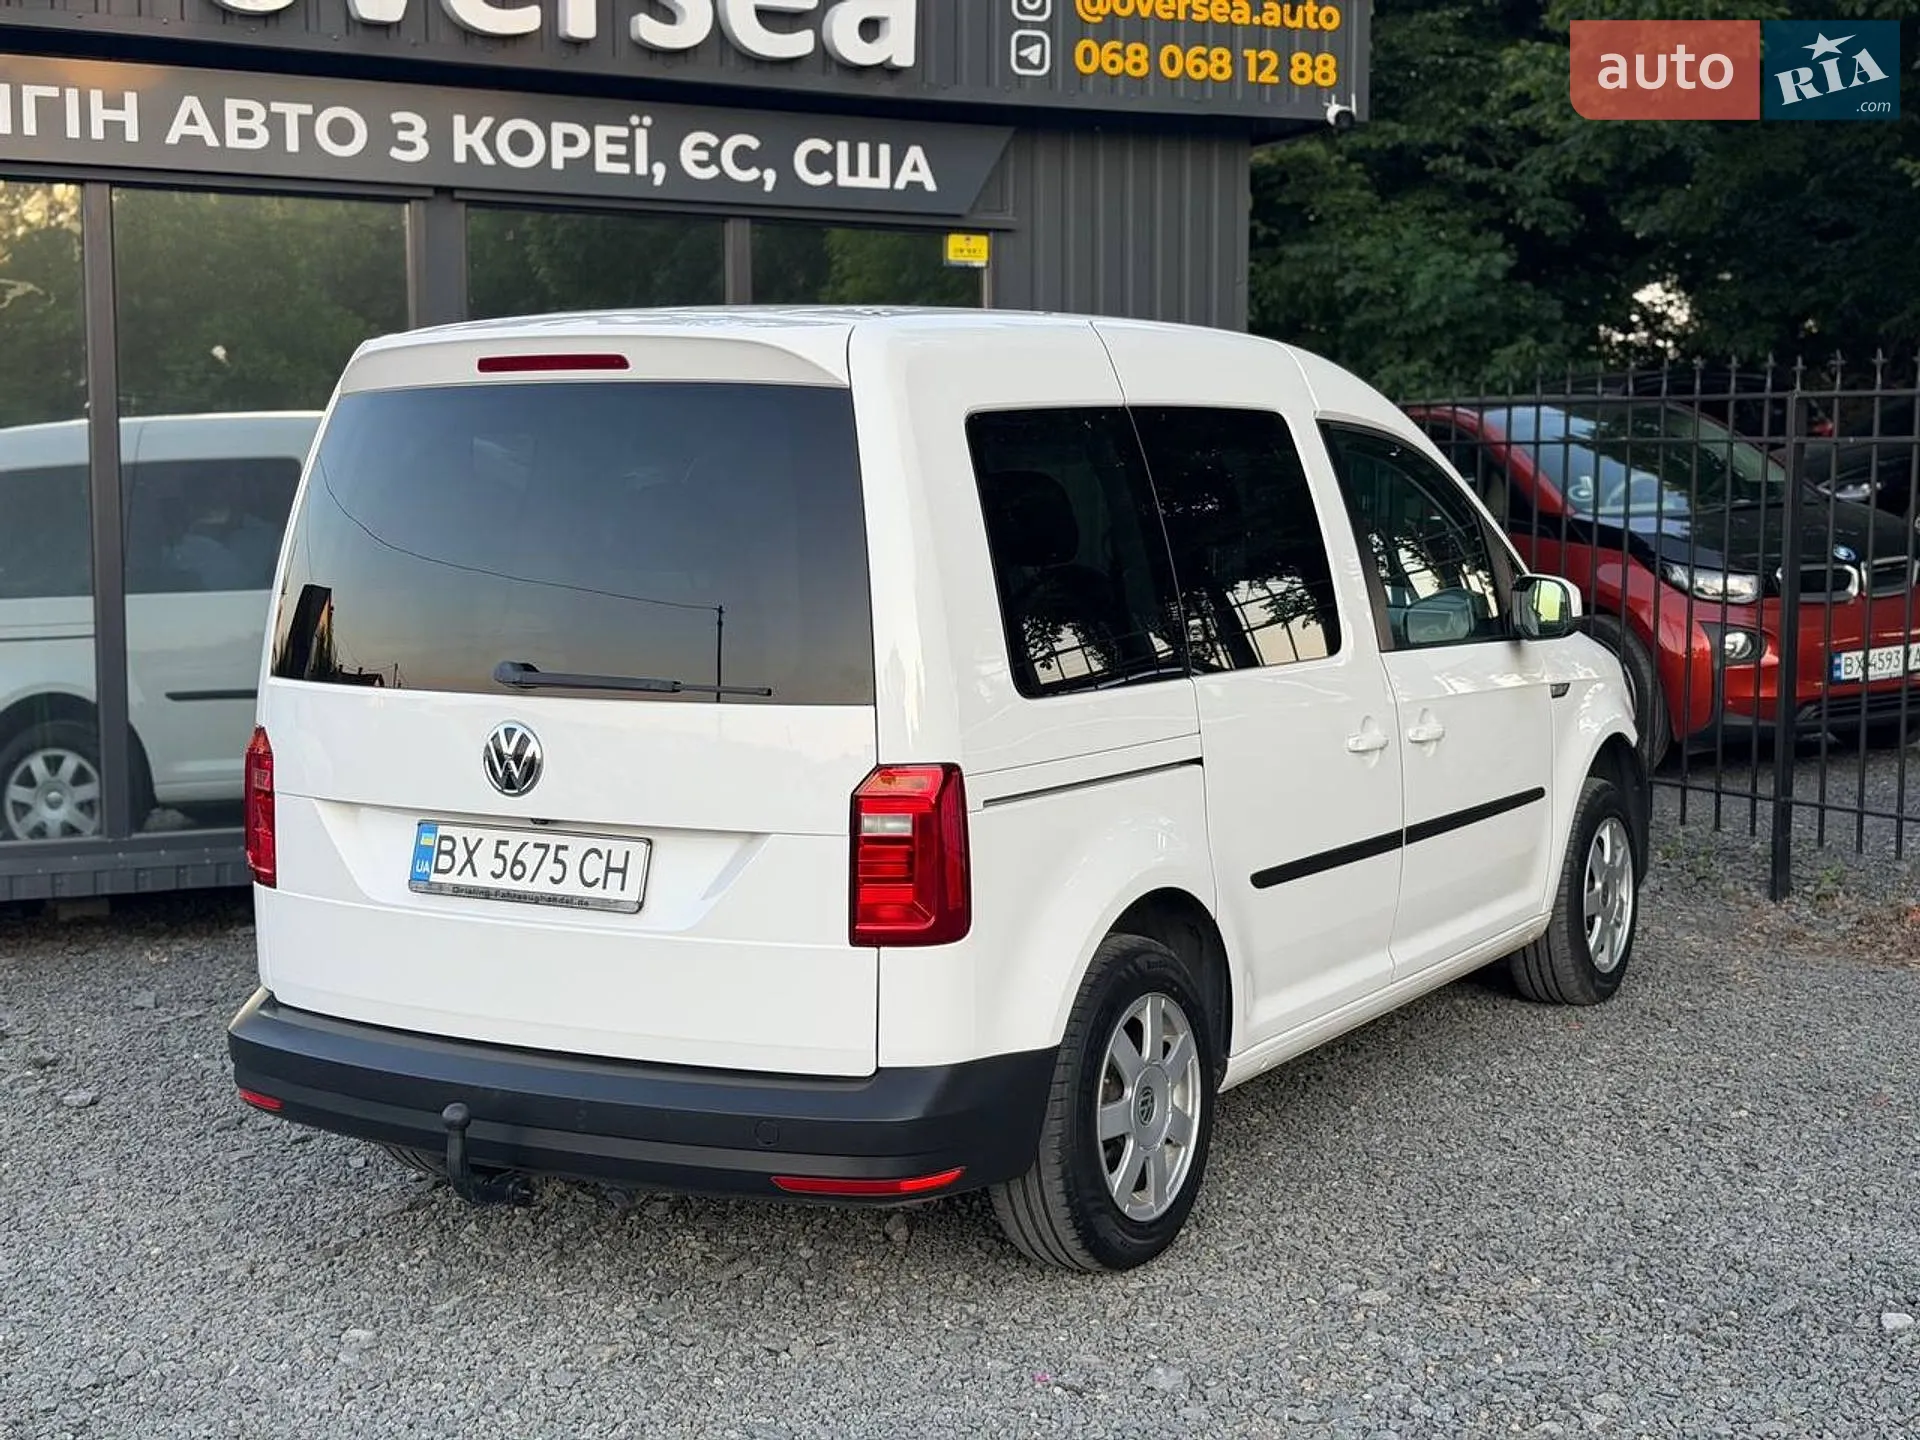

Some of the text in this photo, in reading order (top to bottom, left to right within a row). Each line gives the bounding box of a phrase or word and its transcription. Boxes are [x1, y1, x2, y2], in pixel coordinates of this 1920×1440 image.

[1076, 0, 1341, 31] @oversea.auto
[1074, 39, 1337, 87] 068 068 12 88
[0, 83, 139, 142] ГІН
[165, 96, 368, 158] АВТО
[453, 113, 667, 187] КОРЕЇ,
[680, 132, 776, 192] ЄС,
[793, 138, 938, 192] США
[415, 859, 431, 873] UA
[433, 834, 631, 892] BX 5675 CH
